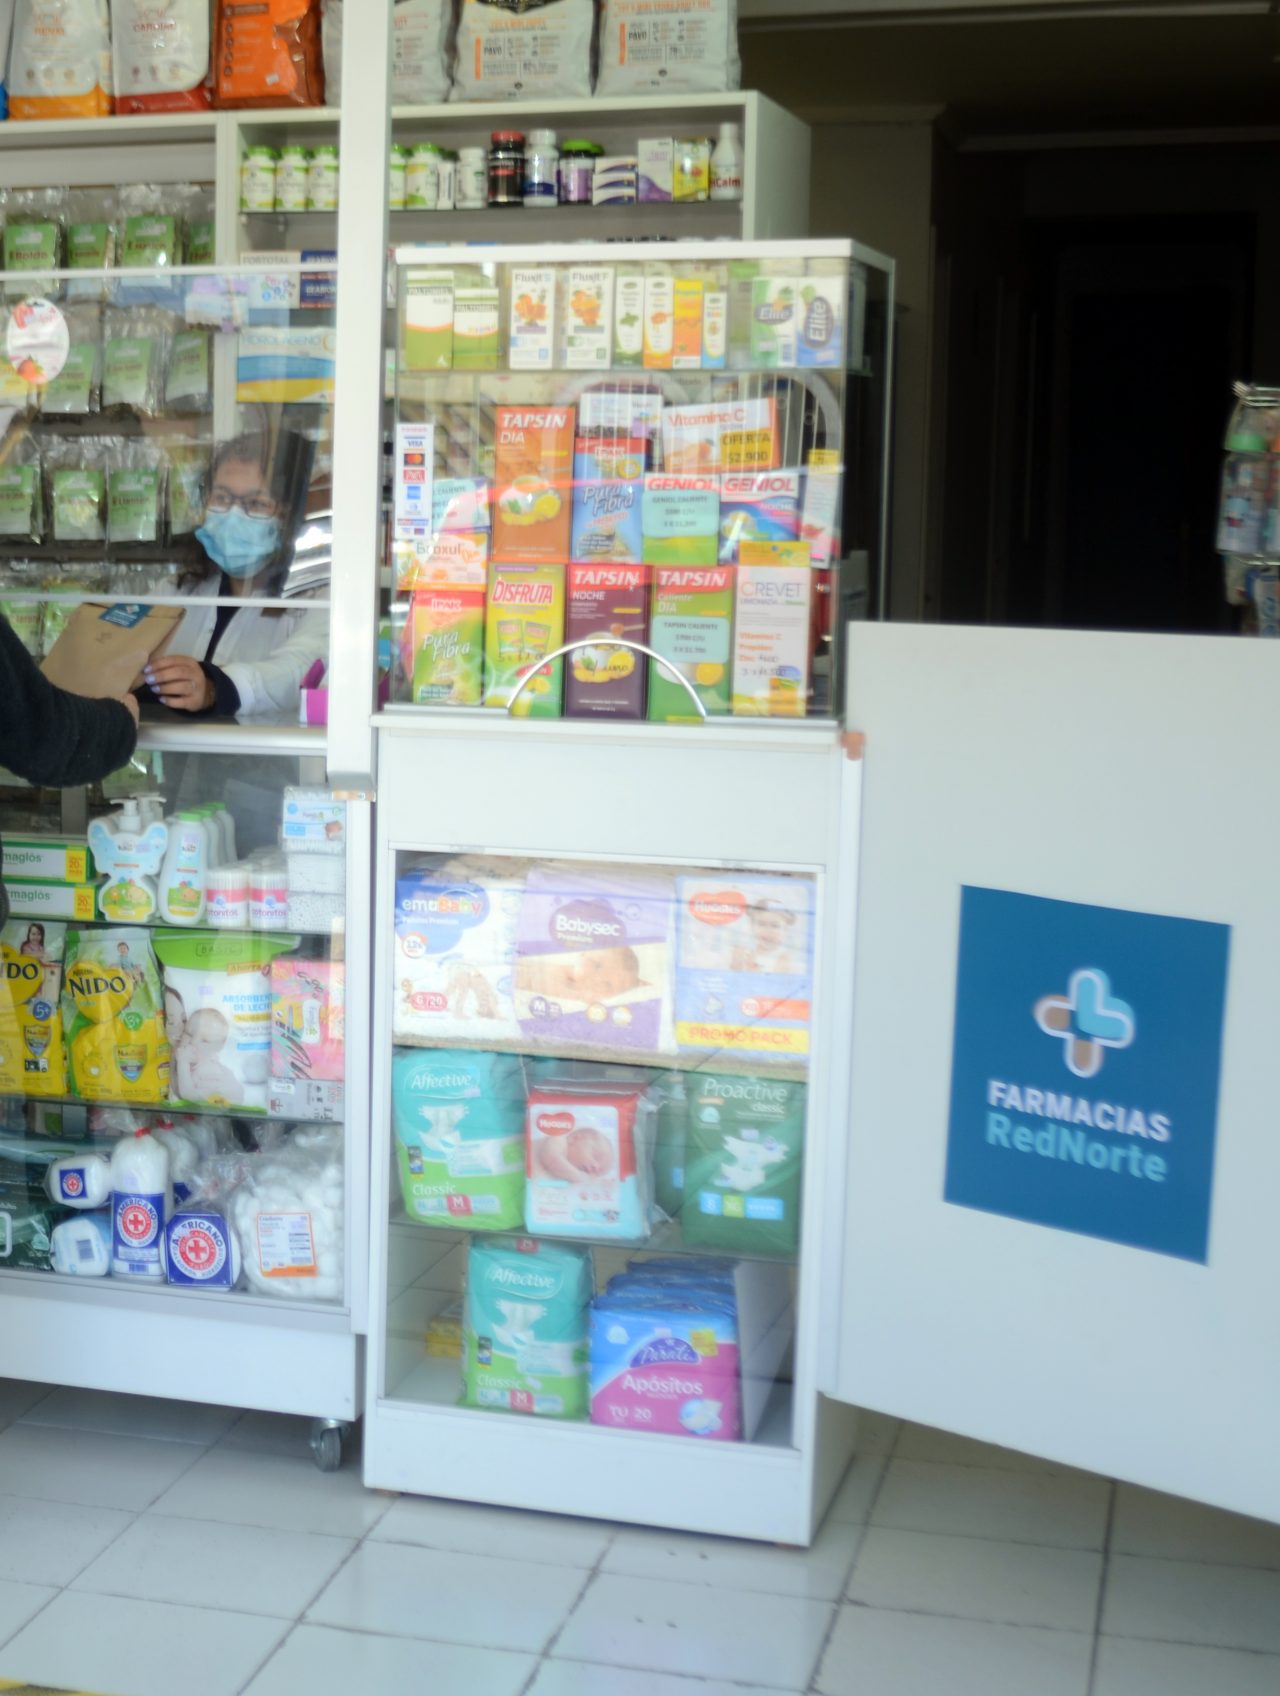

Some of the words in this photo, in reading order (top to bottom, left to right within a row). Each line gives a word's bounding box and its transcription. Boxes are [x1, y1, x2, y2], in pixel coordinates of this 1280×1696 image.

[759, 308, 790, 321] Elite
[811, 300, 826, 341] Elite
[501, 413, 568, 430] TAPSIN
[668, 410, 729, 427] Vitamina
[732, 408, 746, 422] C
[722, 431, 771, 446] OFERTA
[648, 478, 715, 491] GENIOL
[724, 477, 795, 492] GENIOL
[574, 571, 640, 586] TAPSIN
[658, 571, 726, 587] TAPSIN
[492, 580, 554, 604] DISFRUTA
[572, 591, 606, 601] NOCHE
[740, 582, 802, 598] CREVET
[424, 631, 458, 651] Pura
[432, 641, 471, 662] Fibra
[556, 914, 621, 937] Babysec
[69, 976, 127, 998] NIDO
[534, 1000, 546, 1011] M
[688, 1023, 747, 1042] PROMO
[751, 1028, 793, 1046] PACK
[411, 1073, 472, 1090] Affective
[703, 1077, 789, 1103] Proactive
[987, 1078, 1172, 1144] FARMACIAS
[984, 1111, 1169, 1183] RedNorte
[412, 1183, 458, 1197] Classic
[453, 1196, 464, 1208] M
[171, 1218, 224, 1248] AERICANO
[492, 1267, 556, 1290] Affective
[622, 1374, 705, 1397] Apósitos
[514, 1391, 527, 1404] M
[634, 1408, 653, 1421] 20
